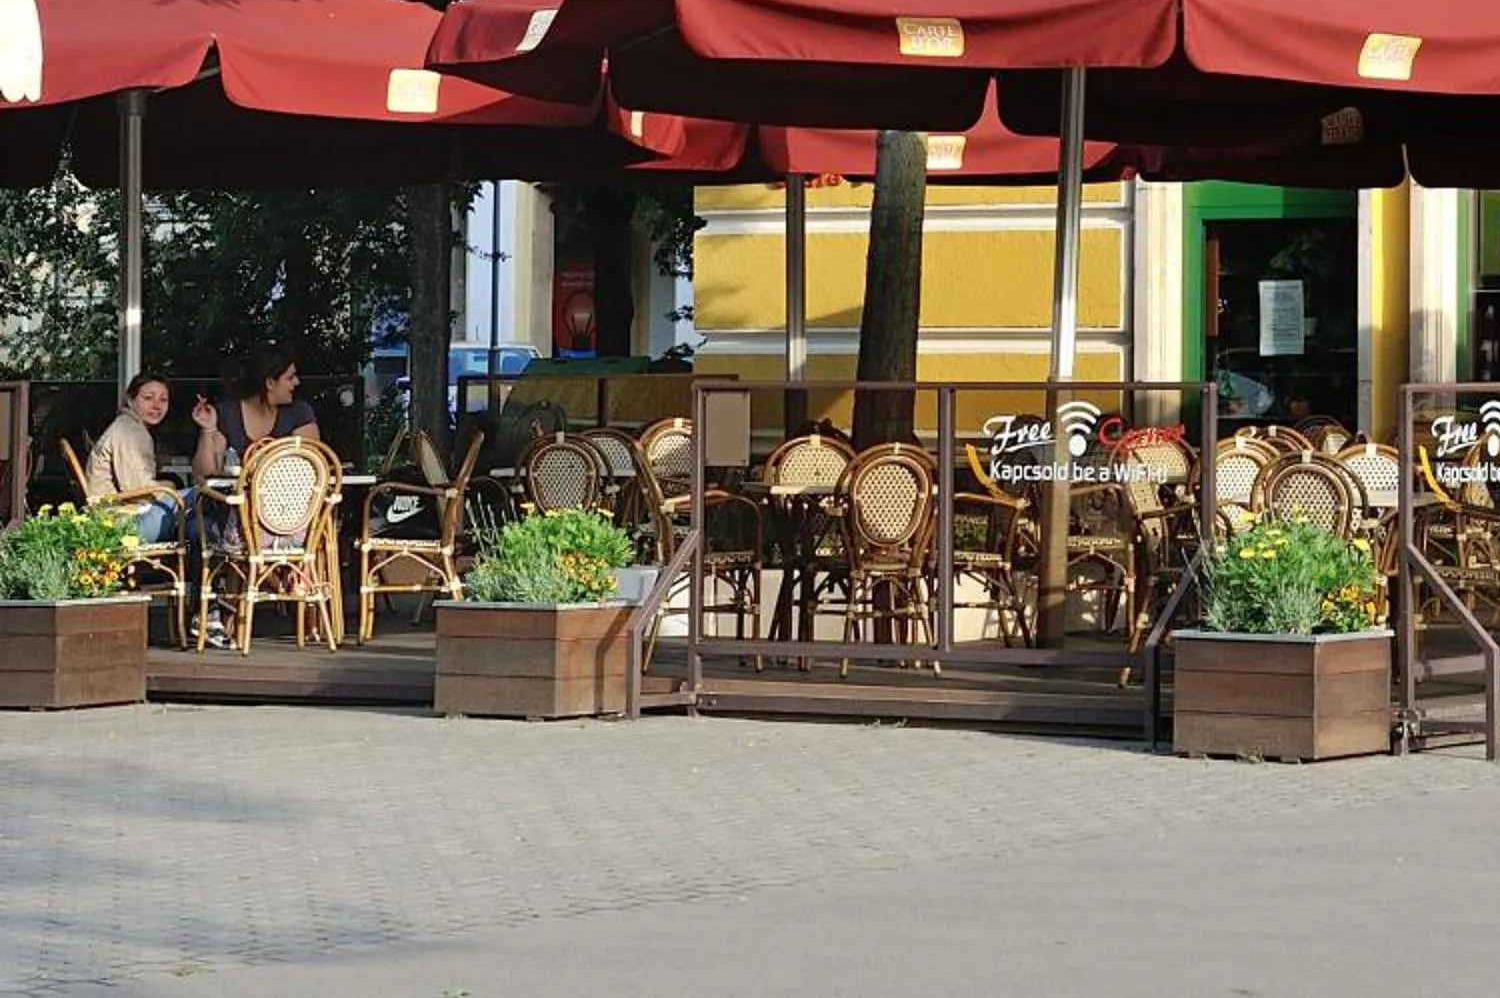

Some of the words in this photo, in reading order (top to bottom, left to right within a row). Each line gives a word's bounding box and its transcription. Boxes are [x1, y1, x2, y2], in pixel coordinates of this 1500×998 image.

[983, 415, 1053, 455] Free
[1431, 415, 1479, 457] Free
[990, 461, 1069, 483] Kapcsold
[1073, 462, 1095, 481] be
[1099, 466, 1110, 482] a
